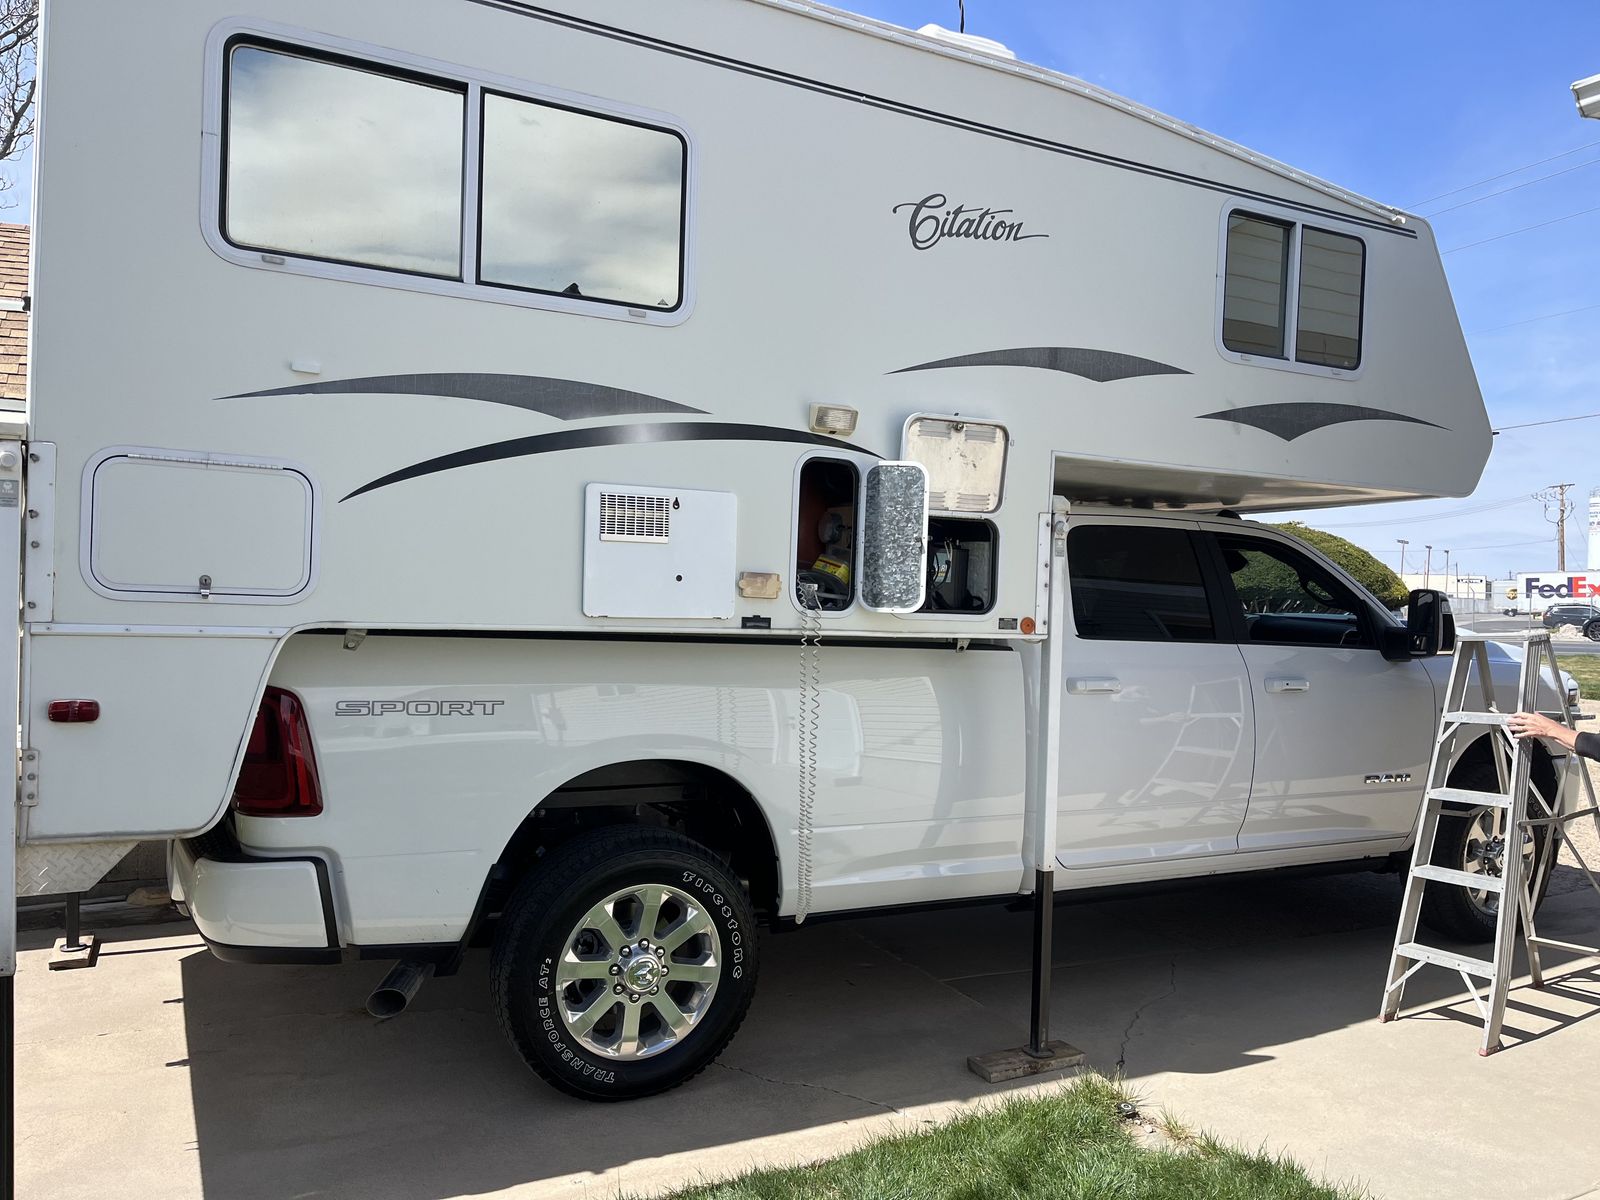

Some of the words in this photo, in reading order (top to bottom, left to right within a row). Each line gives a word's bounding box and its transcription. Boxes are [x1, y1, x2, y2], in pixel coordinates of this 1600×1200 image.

[892, 193, 1049, 250] Citation
[1525, 576, 1600, 598] FedEx
[335, 700, 504, 716] SPORT
[1364, 773, 1411, 784] RAM
[682, 871, 743, 979] Firestone
[538, 997, 615, 1083] TRANSFORCE
